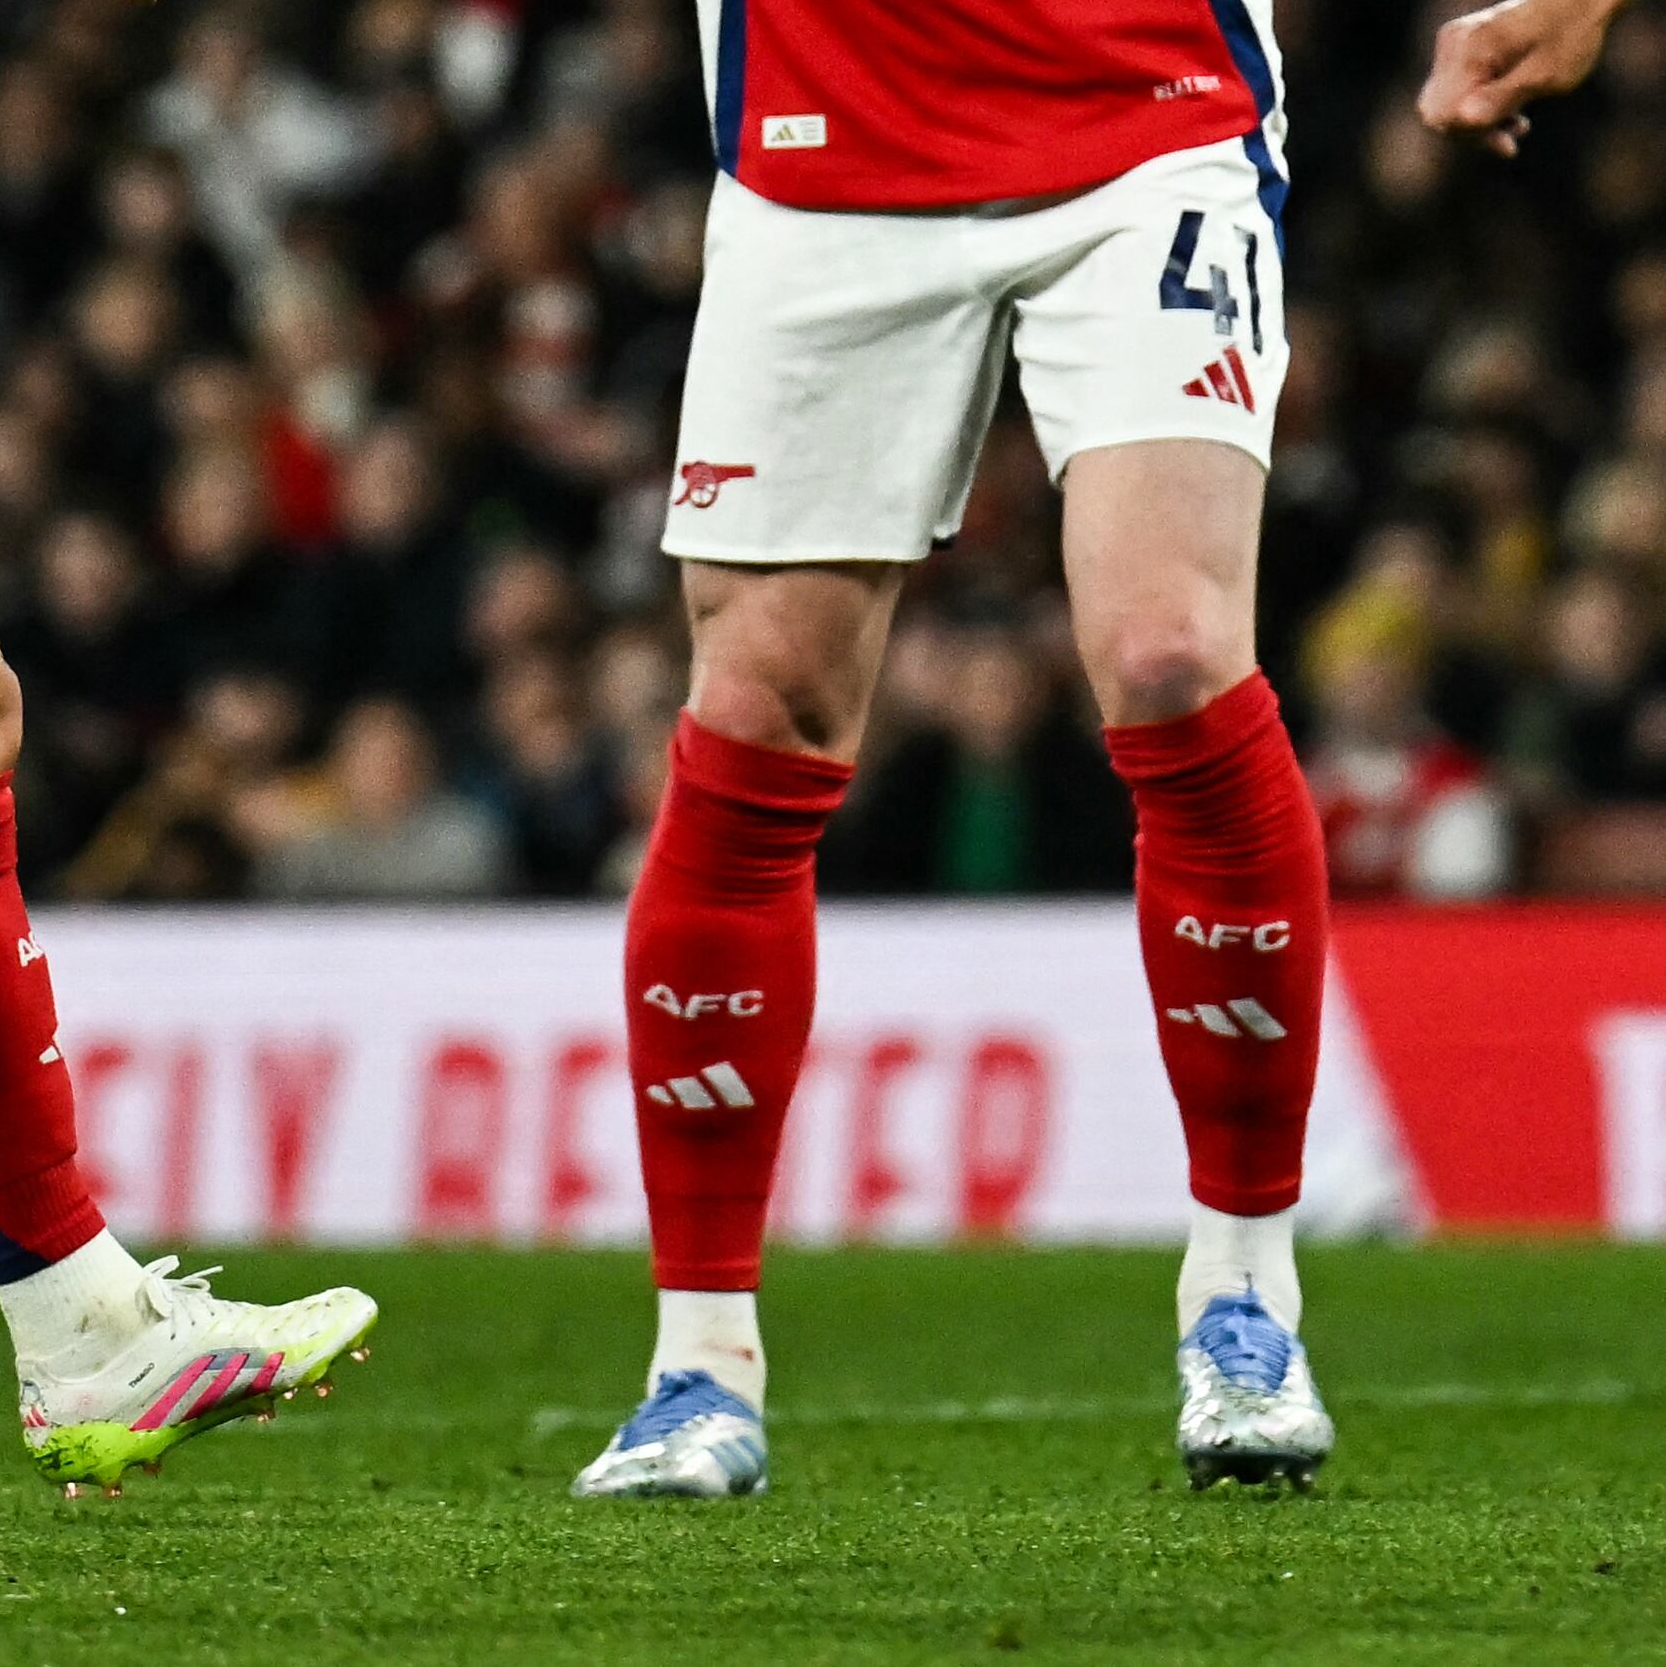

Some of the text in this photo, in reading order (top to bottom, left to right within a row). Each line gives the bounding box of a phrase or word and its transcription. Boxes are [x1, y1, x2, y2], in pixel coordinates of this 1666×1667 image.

[1159, 209, 1264, 356] 41
[1174, 914, 1290, 952] AFC
[642, 983, 765, 1021] AFC
[413, 1028, 1055, 1242] BEER
